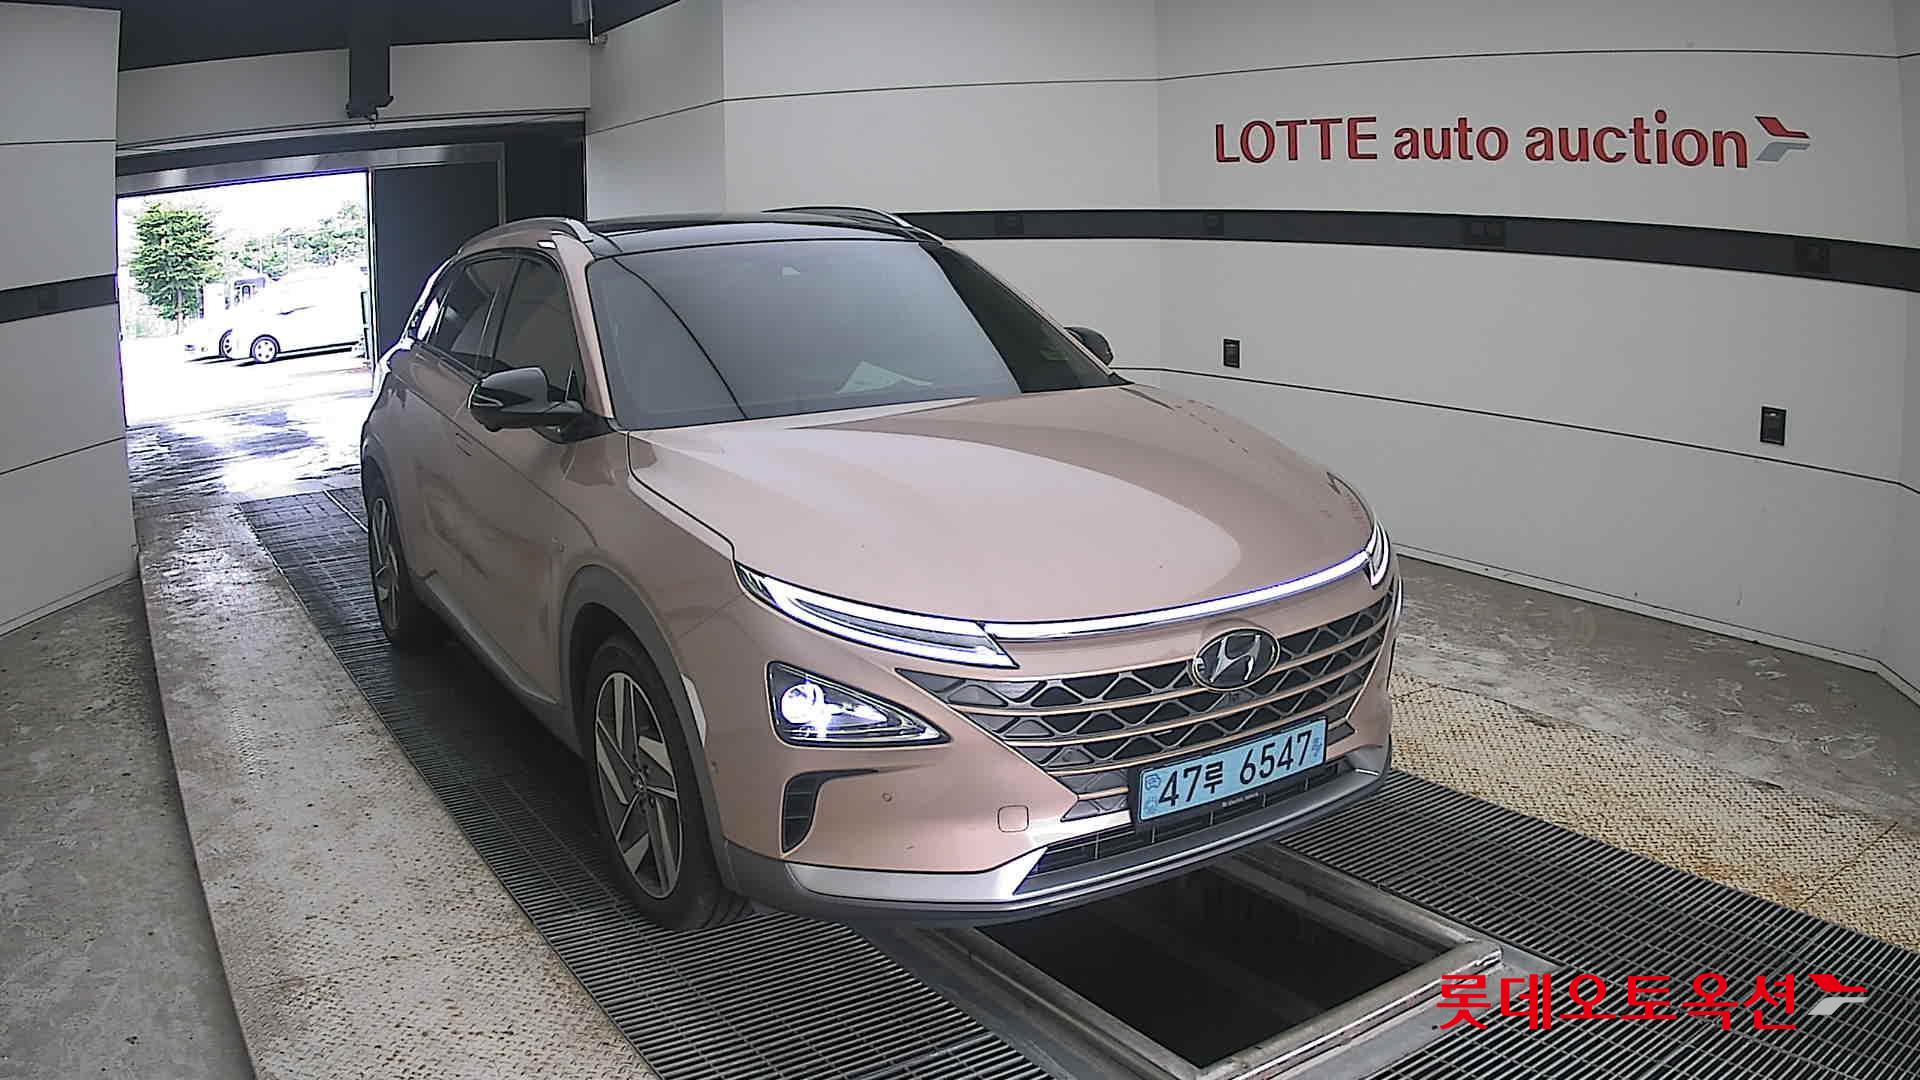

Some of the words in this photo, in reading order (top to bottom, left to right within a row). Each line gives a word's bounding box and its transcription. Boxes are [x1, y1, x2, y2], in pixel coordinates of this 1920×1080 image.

[1215, 116, 1377, 163] LOTTE
[1393, 116, 1509, 161] auto
[1525, 109, 1748, 168] auction
[1158, 760, 1224, 807] 47루
[1239, 729, 1313, 785] 6547
